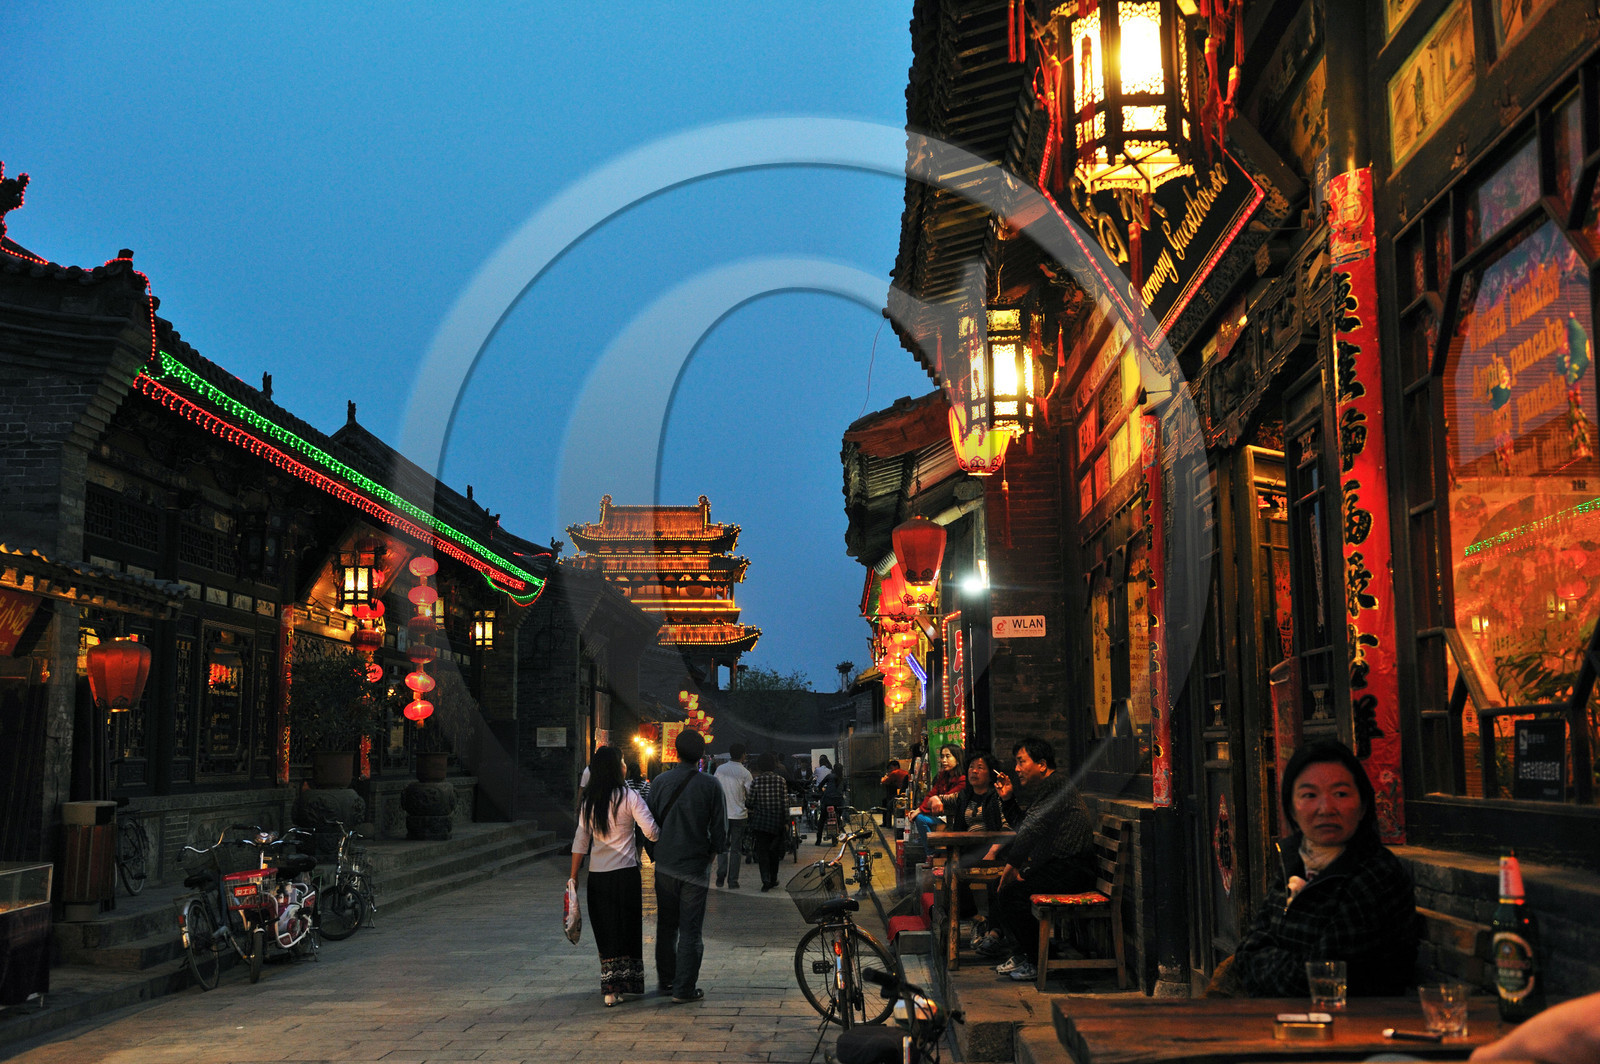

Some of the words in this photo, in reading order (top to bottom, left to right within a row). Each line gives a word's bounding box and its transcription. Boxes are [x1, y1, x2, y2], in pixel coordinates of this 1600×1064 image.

[1161, 162, 1229, 261] Guesthouse
[1509, 317, 1565, 388] pancake
[1516, 372, 1568, 435] pancake
[1012, 618, 1043, 629] WLAN
